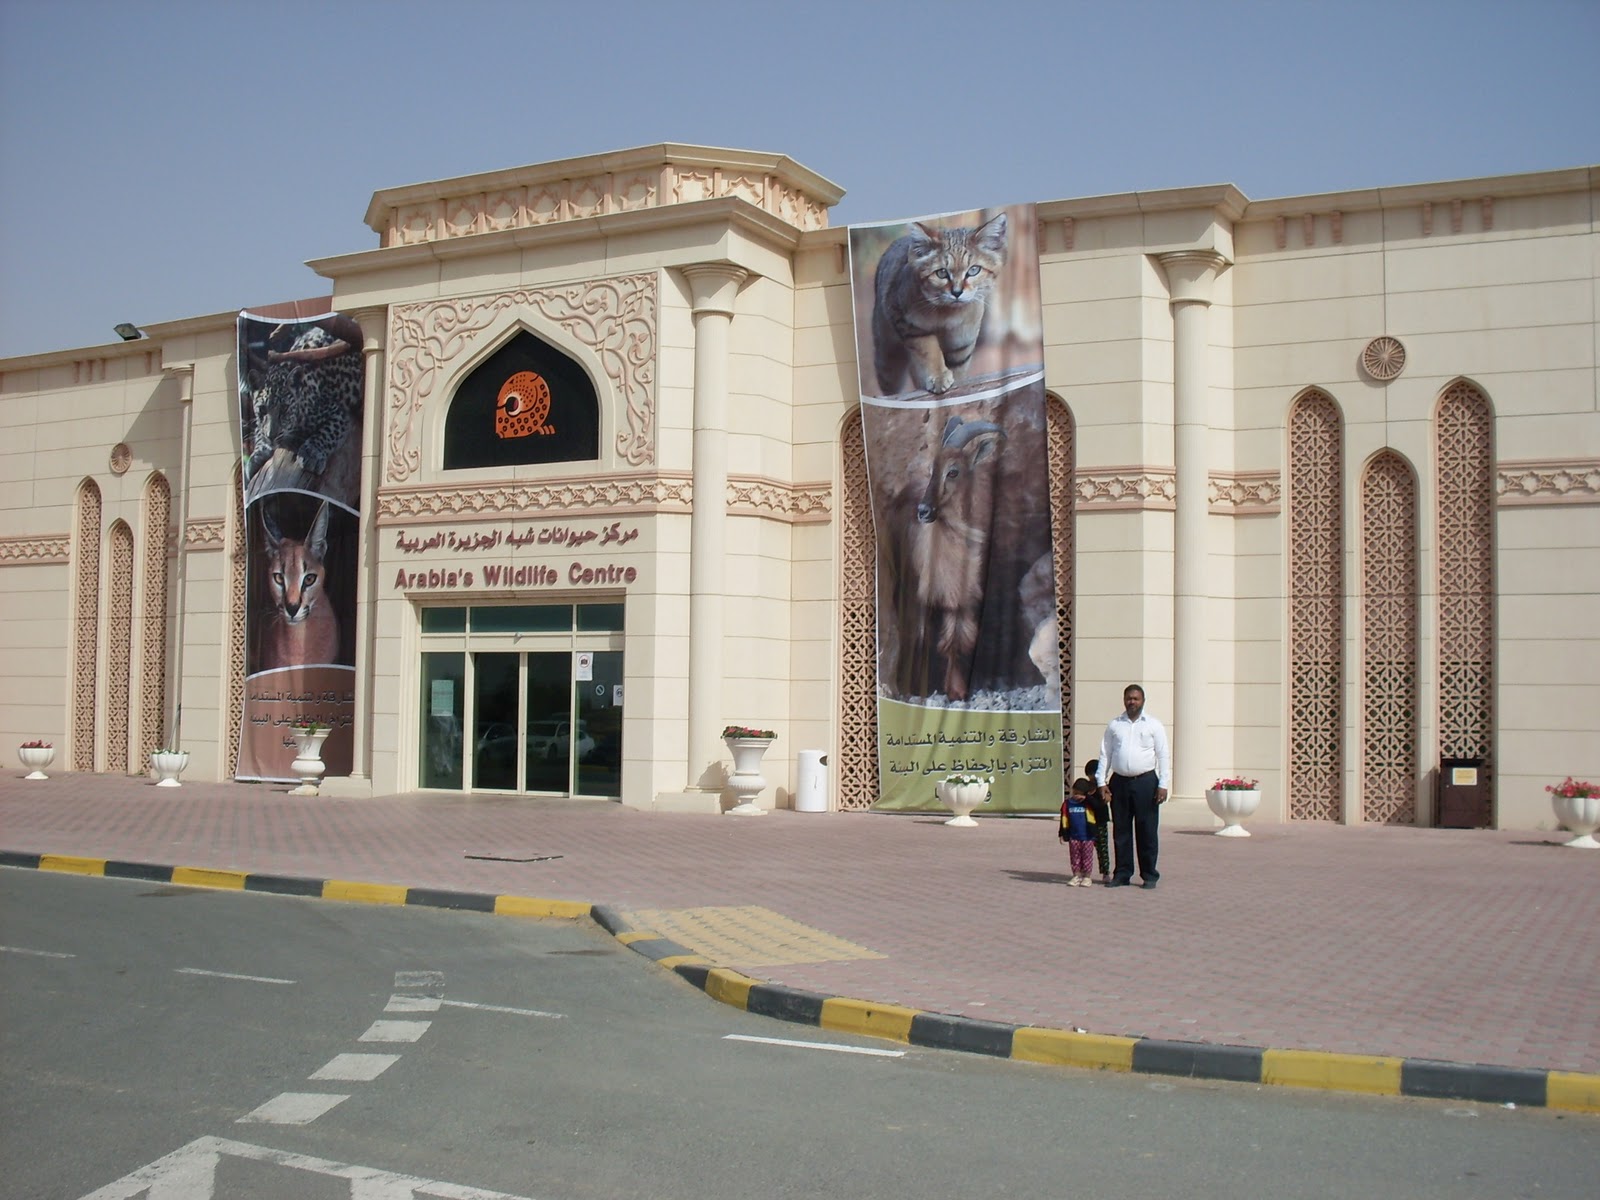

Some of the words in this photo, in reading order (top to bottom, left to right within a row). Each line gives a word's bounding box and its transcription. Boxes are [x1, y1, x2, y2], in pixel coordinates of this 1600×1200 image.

[396, 530, 446, 553] العربية
[448, 529, 502, 551] الجزيرة
[505, 527, 535, 550] شبه
[537, 525, 598, 547] حيوانات
[599, 522, 639, 546] مركز
[394, 568, 474, 589] Arabia's
[483, 564, 558, 587] Wildlife
[568, 562, 637, 585] Centre
[886, 732, 937, 747] المستدامة
[938, 730, 995, 747] والتنمية
[998, 728, 1055, 747] الشارقة
[922, 760, 947, 776] على
[951, 759, 1008, 774] بالحفاظ
[1010, 757, 1053, 774] التزام
